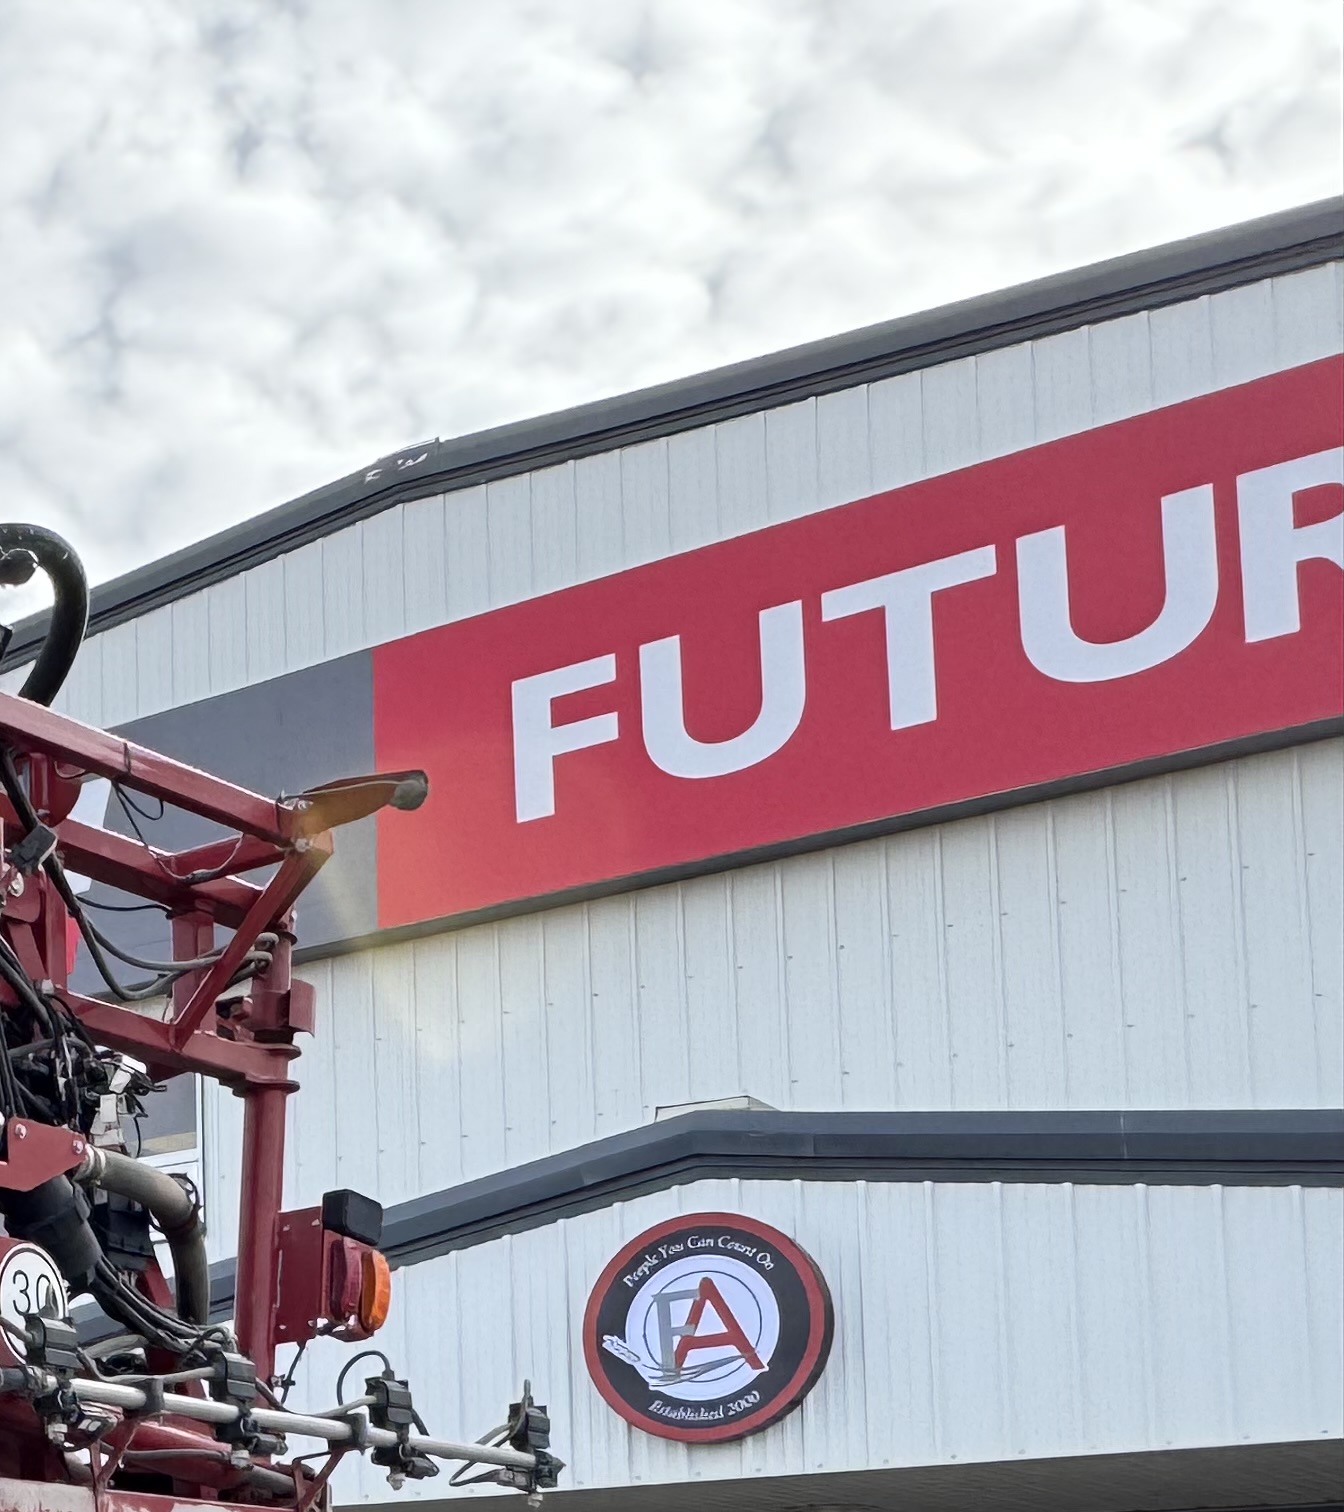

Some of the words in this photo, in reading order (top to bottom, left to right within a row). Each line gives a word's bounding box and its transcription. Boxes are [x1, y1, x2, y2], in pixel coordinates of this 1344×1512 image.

[510, 446, 1344, 824] FUTUR
[623, 1254, 659, 1287] People
[658, 1243, 684, 1259] You
[687, 1235, 714, 1249] Can
[717, 1235, 758, 1257] Count
[756, 1252, 775, 1271] On
[648, 1399, 724, 1421] Established
